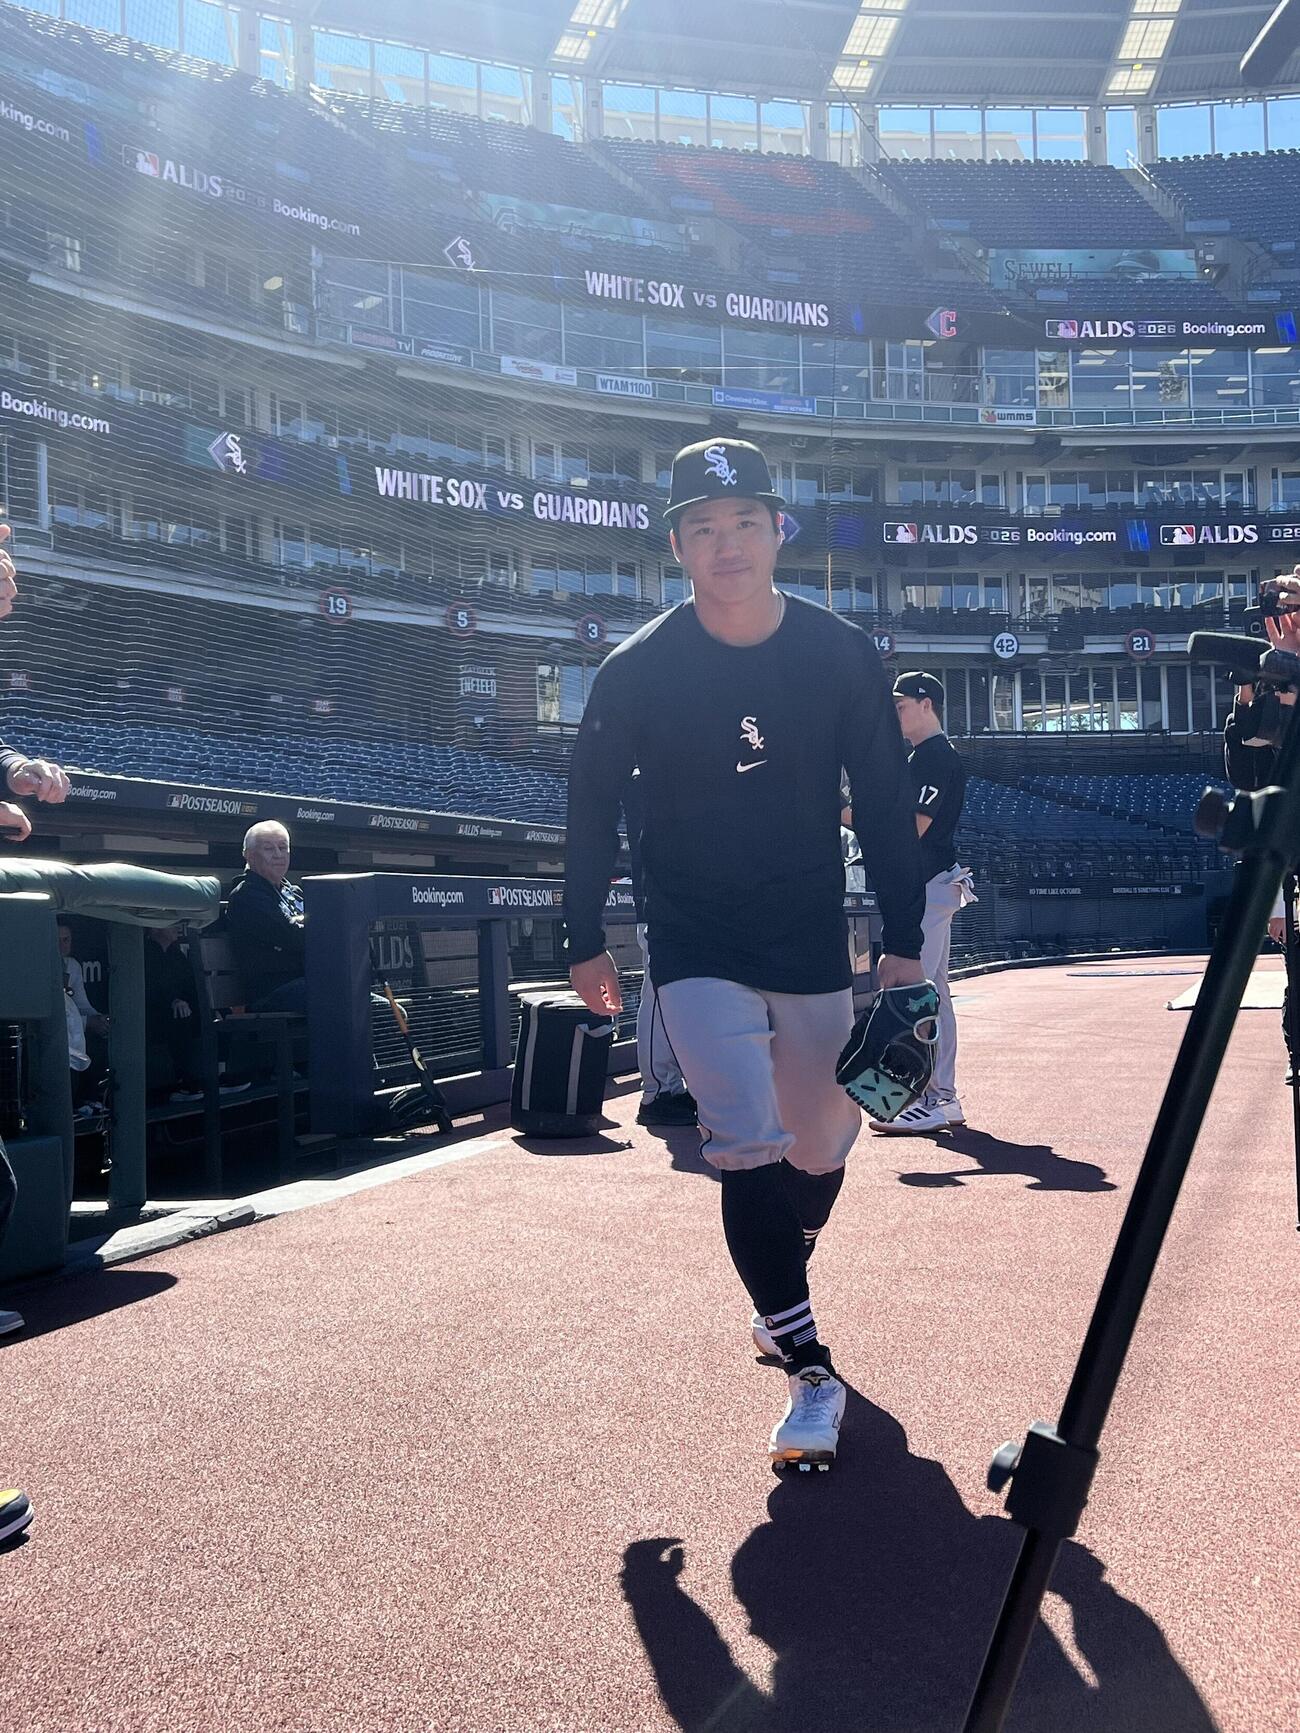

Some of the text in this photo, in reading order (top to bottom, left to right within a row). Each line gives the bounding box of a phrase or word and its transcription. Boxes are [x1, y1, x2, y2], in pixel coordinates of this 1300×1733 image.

[162, 159, 223, 198] ALDS
[273, 198, 360, 236] Booking.com
[584, 270, 645, 303] WHITE
[647, 281, 685, 309] SOX
[726, 293, 830, 327] GUARDIANS
[1080, 320, 1136, 338] ALDS
[1182, 321, 1266, 337] Booking.com
[1, 391, 110, 434] Booking.com
[375, 466, 443, 505] WHITE
[446, 478, 488, 511] SOX
[533, 492, 650, 530] GUARDIANS
[920, 525, 978, 544] ALDS
[1027, 529, 1117, 545] Booking.com
[1198, 525, 1259, 544] ALDS
[328, 596, 347, 614] 19
[457, 612, 468, 628] 5
[588, 623, 599, 639] 3
[996, 639, 1015, 653] 42
[1132, 637, 1151, 651] 21
[180, 794, 242, 815] POSTSEASON
[919, 785, 939, 805] 17
[297, 803, 335, 822] Booking.com
[376, 814, 418, 830] POSTSEASON
[412, 886, 465, 907] Booking.com
[500, 886, 553, 907] POSTSEASON
